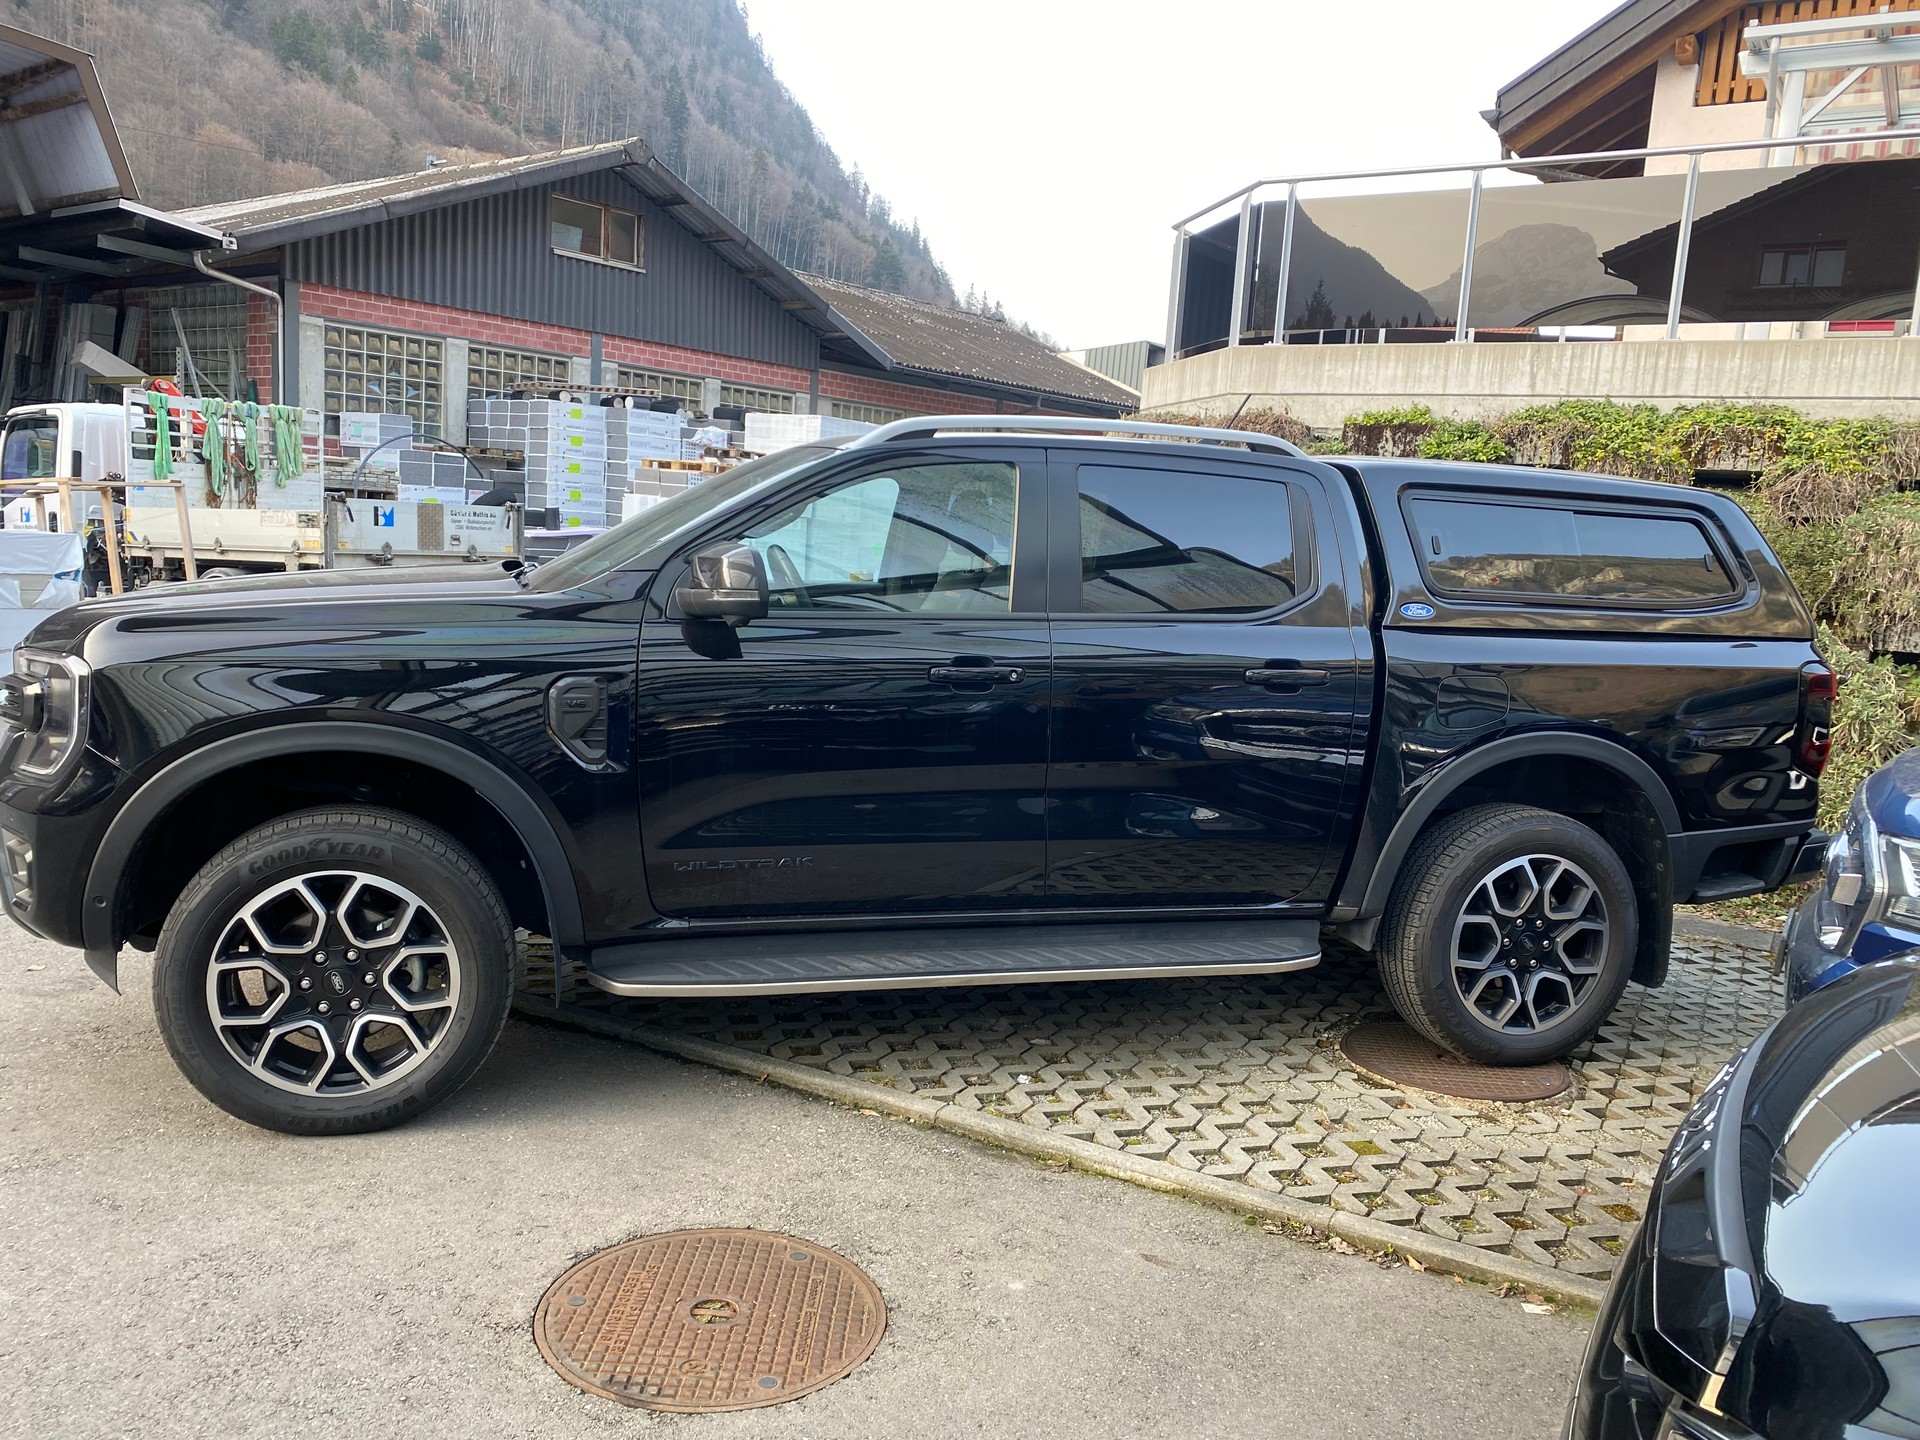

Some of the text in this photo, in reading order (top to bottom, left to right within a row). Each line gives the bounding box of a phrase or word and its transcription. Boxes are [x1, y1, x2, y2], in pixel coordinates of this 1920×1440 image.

[1406, 604, 1429, 616] Ford
[566, 699, 586, 708] V6
[248, 840, 386, 875] GOODYEAR
[673, 857, 814, 871] WILDTRAK
